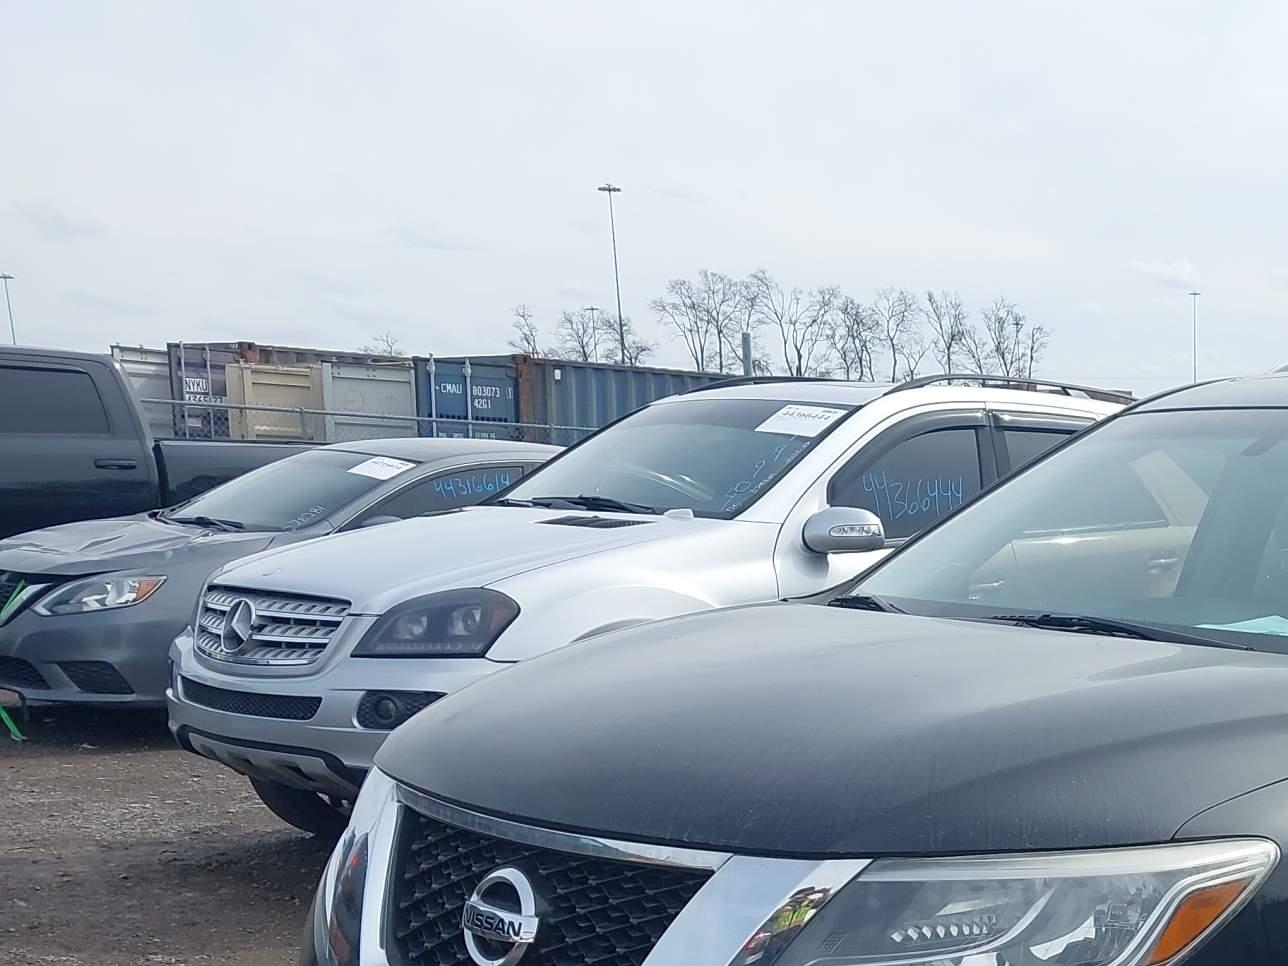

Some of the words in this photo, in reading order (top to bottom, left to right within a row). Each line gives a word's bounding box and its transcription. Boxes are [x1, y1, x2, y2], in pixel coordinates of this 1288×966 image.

[185, 378, 208, 392] NYKU
[440, 383, 463, 394] CMAU
[472, 385, 500, 398] 803073
[473, 398, 491, 409] 42G1
[432, 472, 513, 499] 44316614
[862, 471, 963, 521] 44366444
[463, 902, 523, 938] NISSAN
